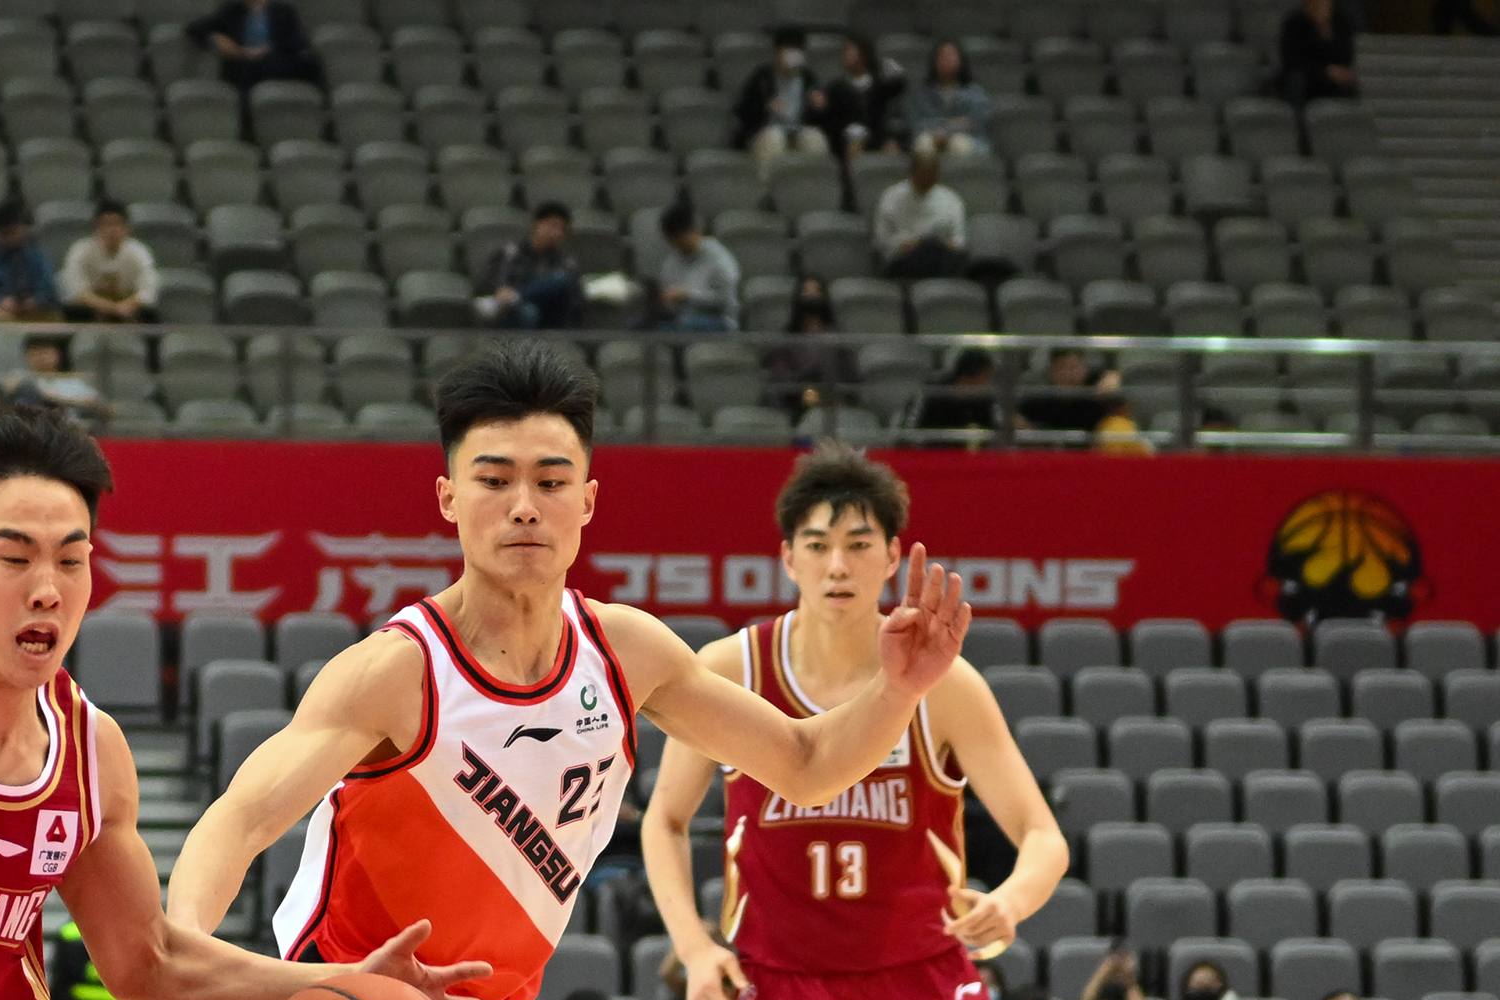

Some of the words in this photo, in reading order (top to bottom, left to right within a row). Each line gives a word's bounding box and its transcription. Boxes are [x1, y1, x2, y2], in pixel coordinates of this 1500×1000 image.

[723, 555, 1136, 610] DONS
[576, 713, 609, 728] 中国人寿
[576, 726, 595, 735] CHINA
[595, 723, 609, 731] LIFE
[453, 741, 582, 906] JIANGSU
[38, 850, 68, 861] 广发银行
[42, 862, 59, 873] CGB
[810, 843, 864, 896] 13
